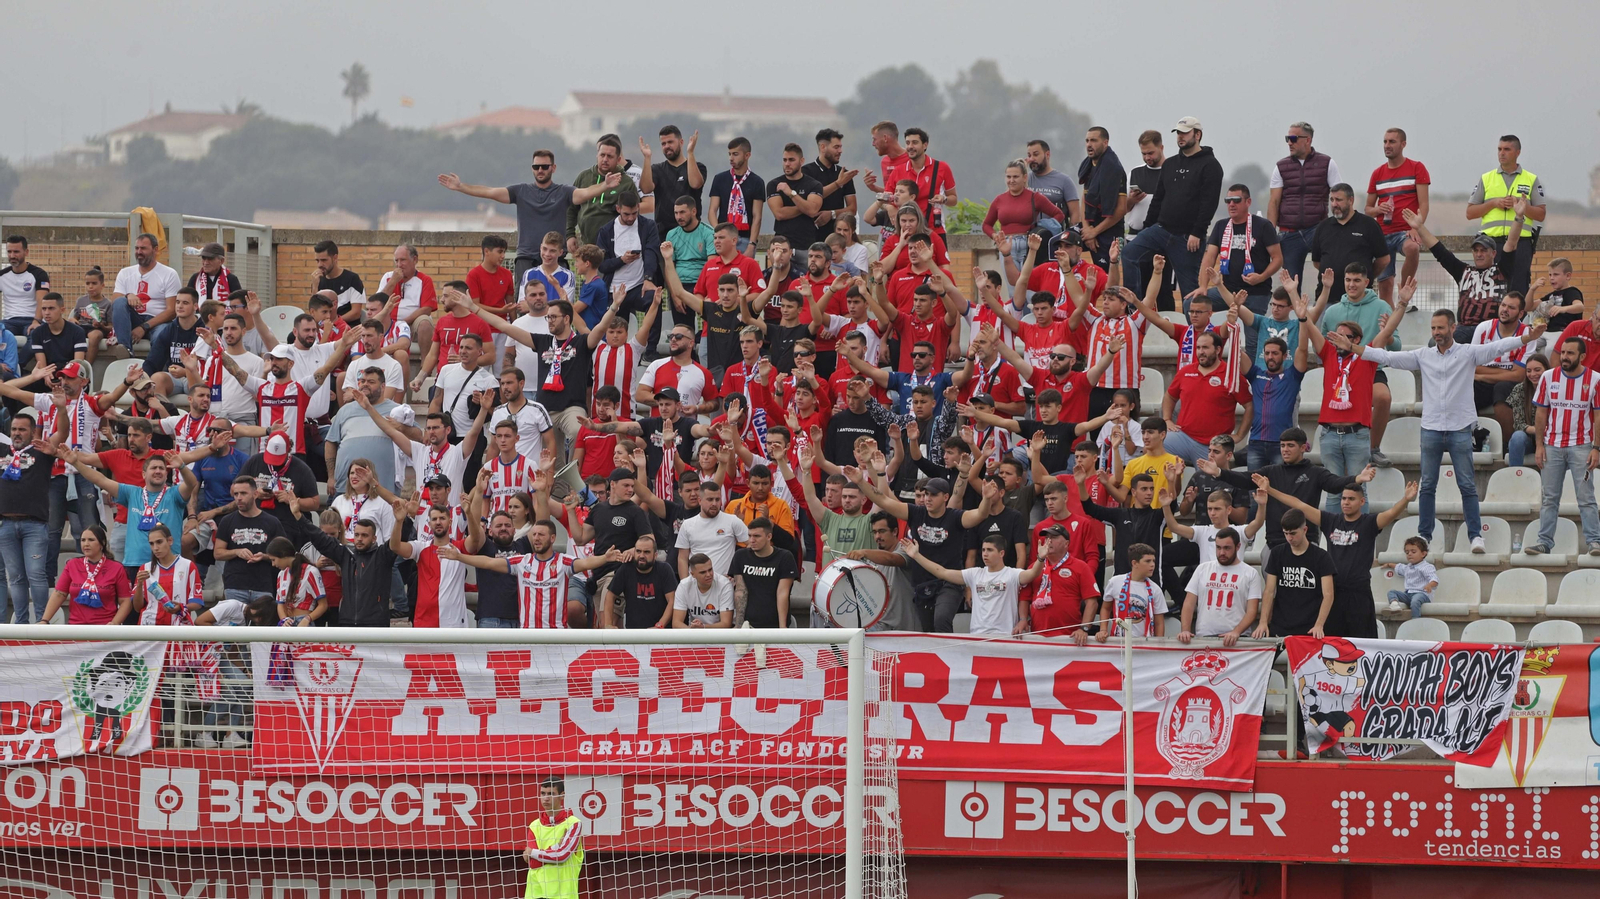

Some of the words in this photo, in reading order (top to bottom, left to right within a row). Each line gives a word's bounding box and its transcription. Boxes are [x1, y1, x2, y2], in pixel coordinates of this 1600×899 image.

[743, 565, 776, 576] TOMMY
[1283, 566, 1301, 574] UNA
[1278, 580, 1301, 588] LOCA
[1316, 681, 1342, 695] 1909
[1361, 650, 1445, 710] YOUTH
[1445, 650, 1519, 707] BOYS
[391, 647, 1125, 746] ALGECIRAS
[579, 739, 673, 756] GRADA
[689, 739, 744, 757] ACF
[868, 744, 925, 760] SUR
[210, 779, 478, 827] BESOCCER
[633, 784, 896, 828] BESOCCR
[1015, 787, 1287, 837] BESOCCER
[48, 822, 86, 836] ver
[1424, 840, 1562, 859] tendencias
